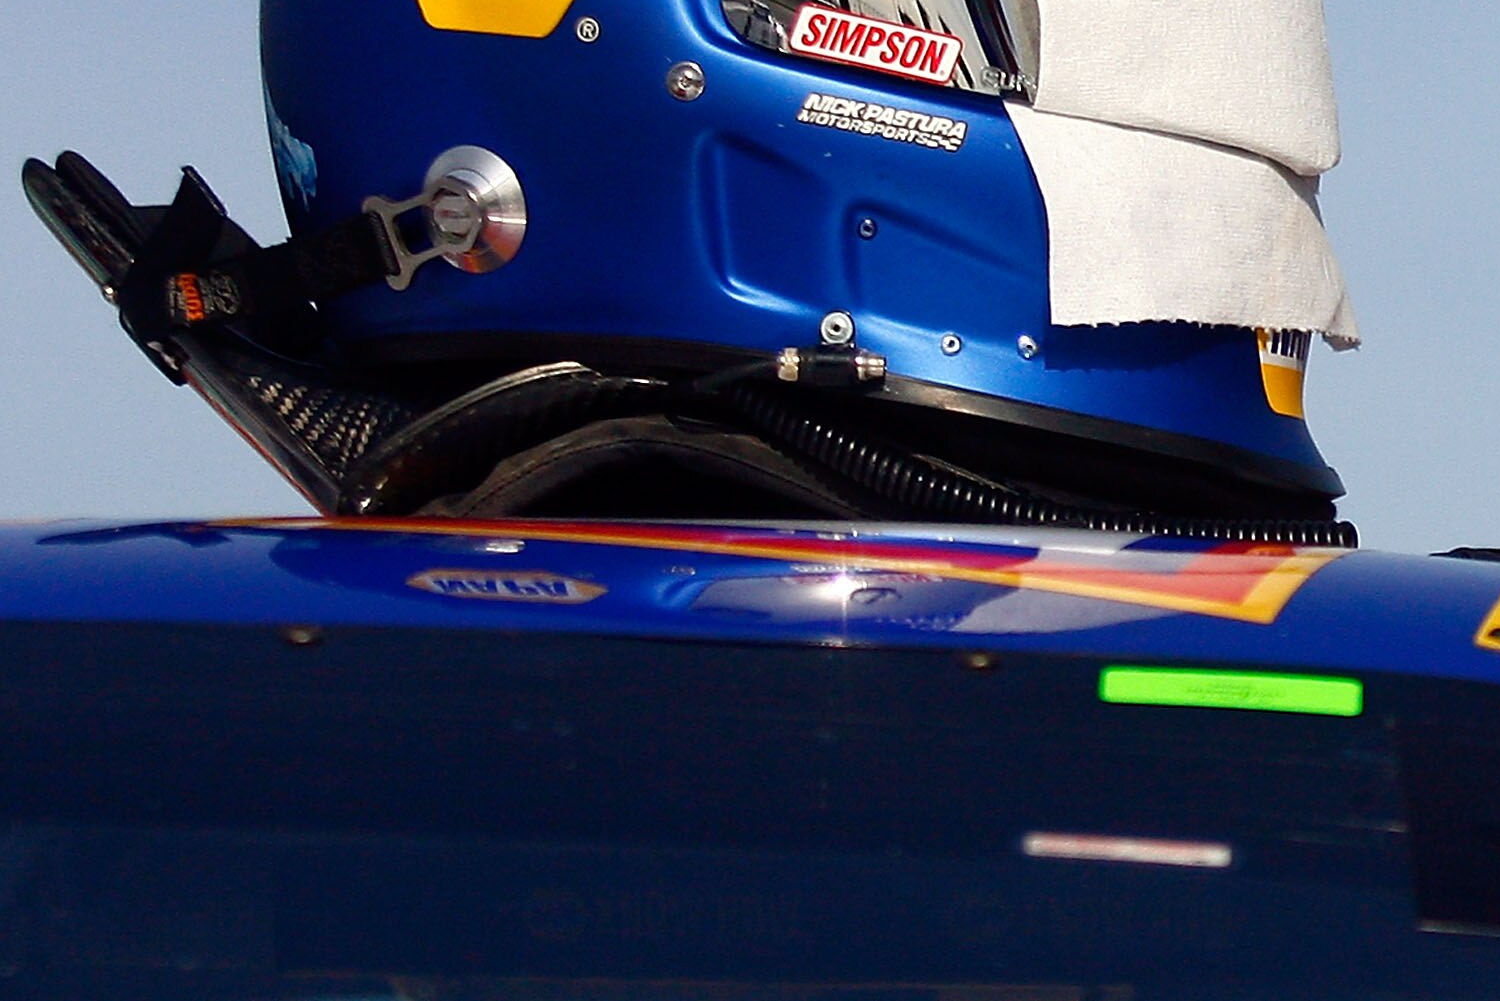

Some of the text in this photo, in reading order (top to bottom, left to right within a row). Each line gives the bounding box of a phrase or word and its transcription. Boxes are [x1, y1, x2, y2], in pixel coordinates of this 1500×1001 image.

[800, 13, 949, 75] SIMPSON
[803, 93, 968, 140] NICK PASTURA
